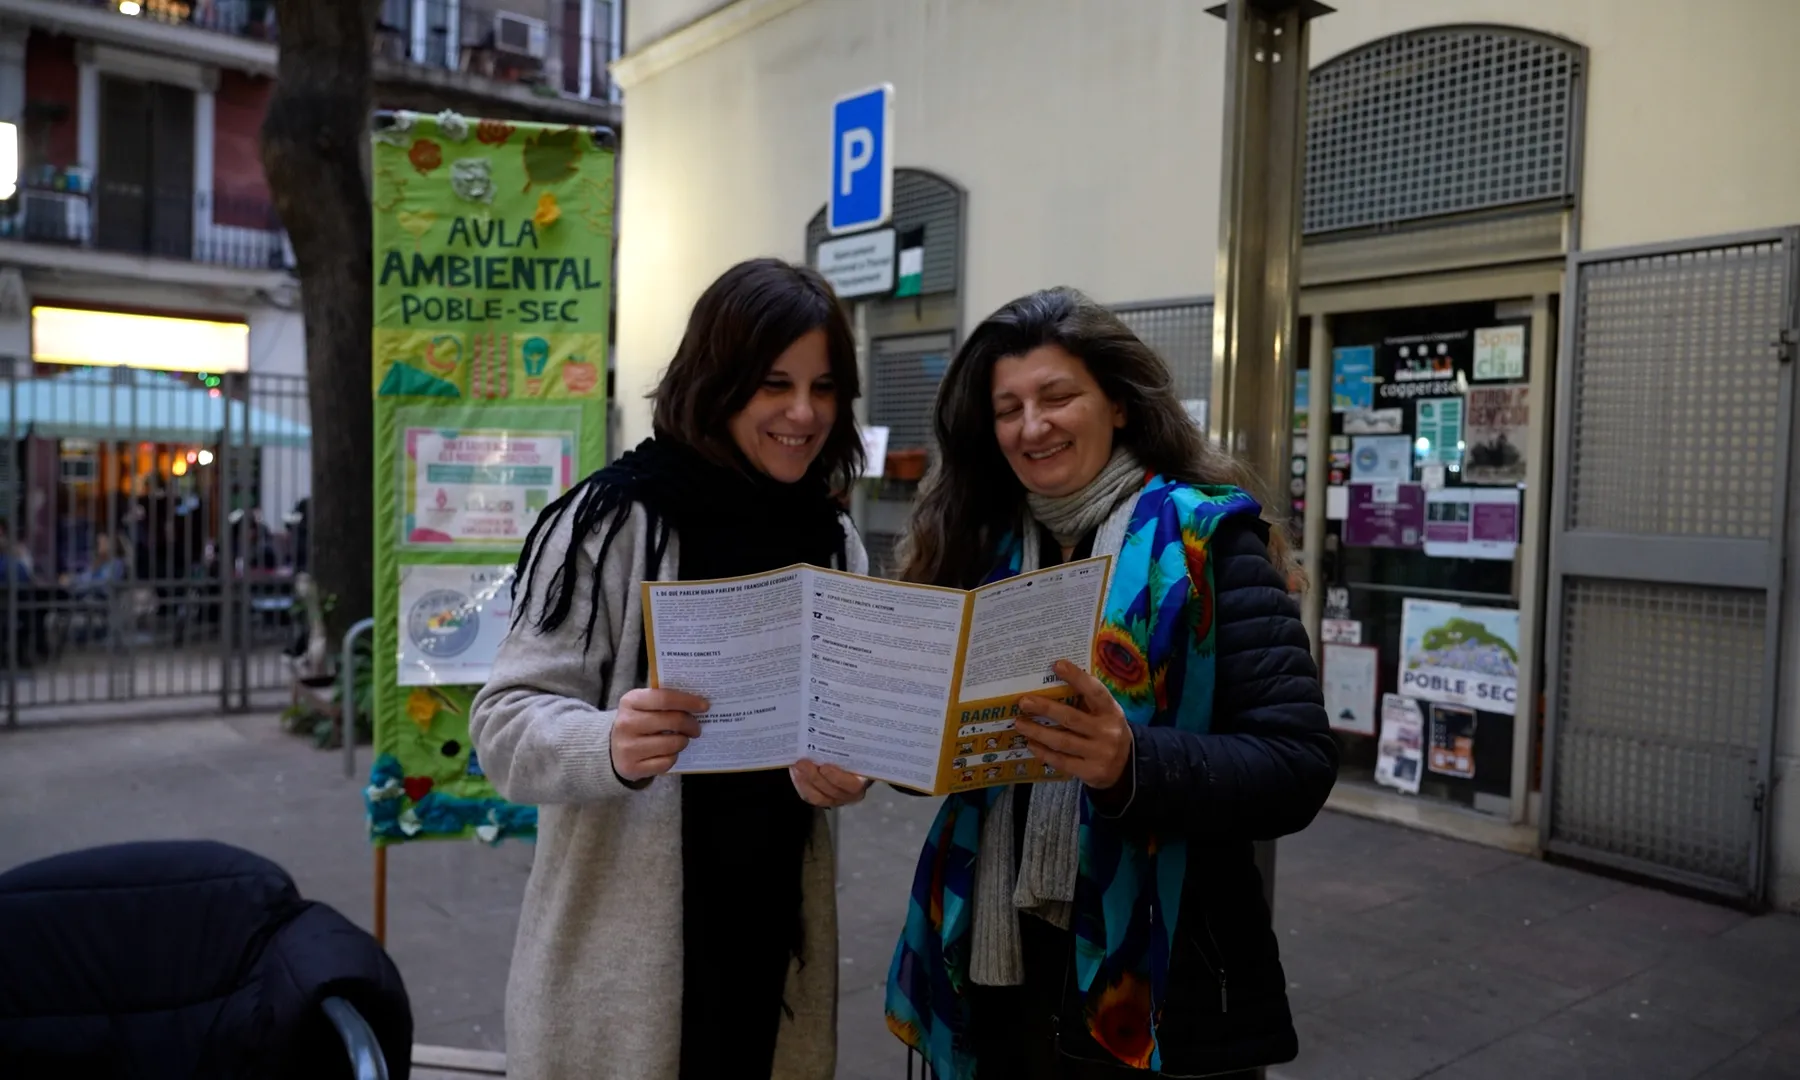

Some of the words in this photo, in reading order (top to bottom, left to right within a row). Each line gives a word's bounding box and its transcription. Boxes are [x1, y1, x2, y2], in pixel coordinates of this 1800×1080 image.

[841, 126, 874, 196] P
[448, 216, 538, 249] AULA
[379, 251, 601, 291] AMBIENTAL
[401, 294, 579, 324] POBLE-SEC
[715, 585, 736, 593] PARLEM
[743, 580, 769, 590] TRANSICIÓ
[1403, 671, 1466, 695] POBLE
[1476, 682, 1517, 703] SEC
[960, 705, 1007, 723] BARRI
